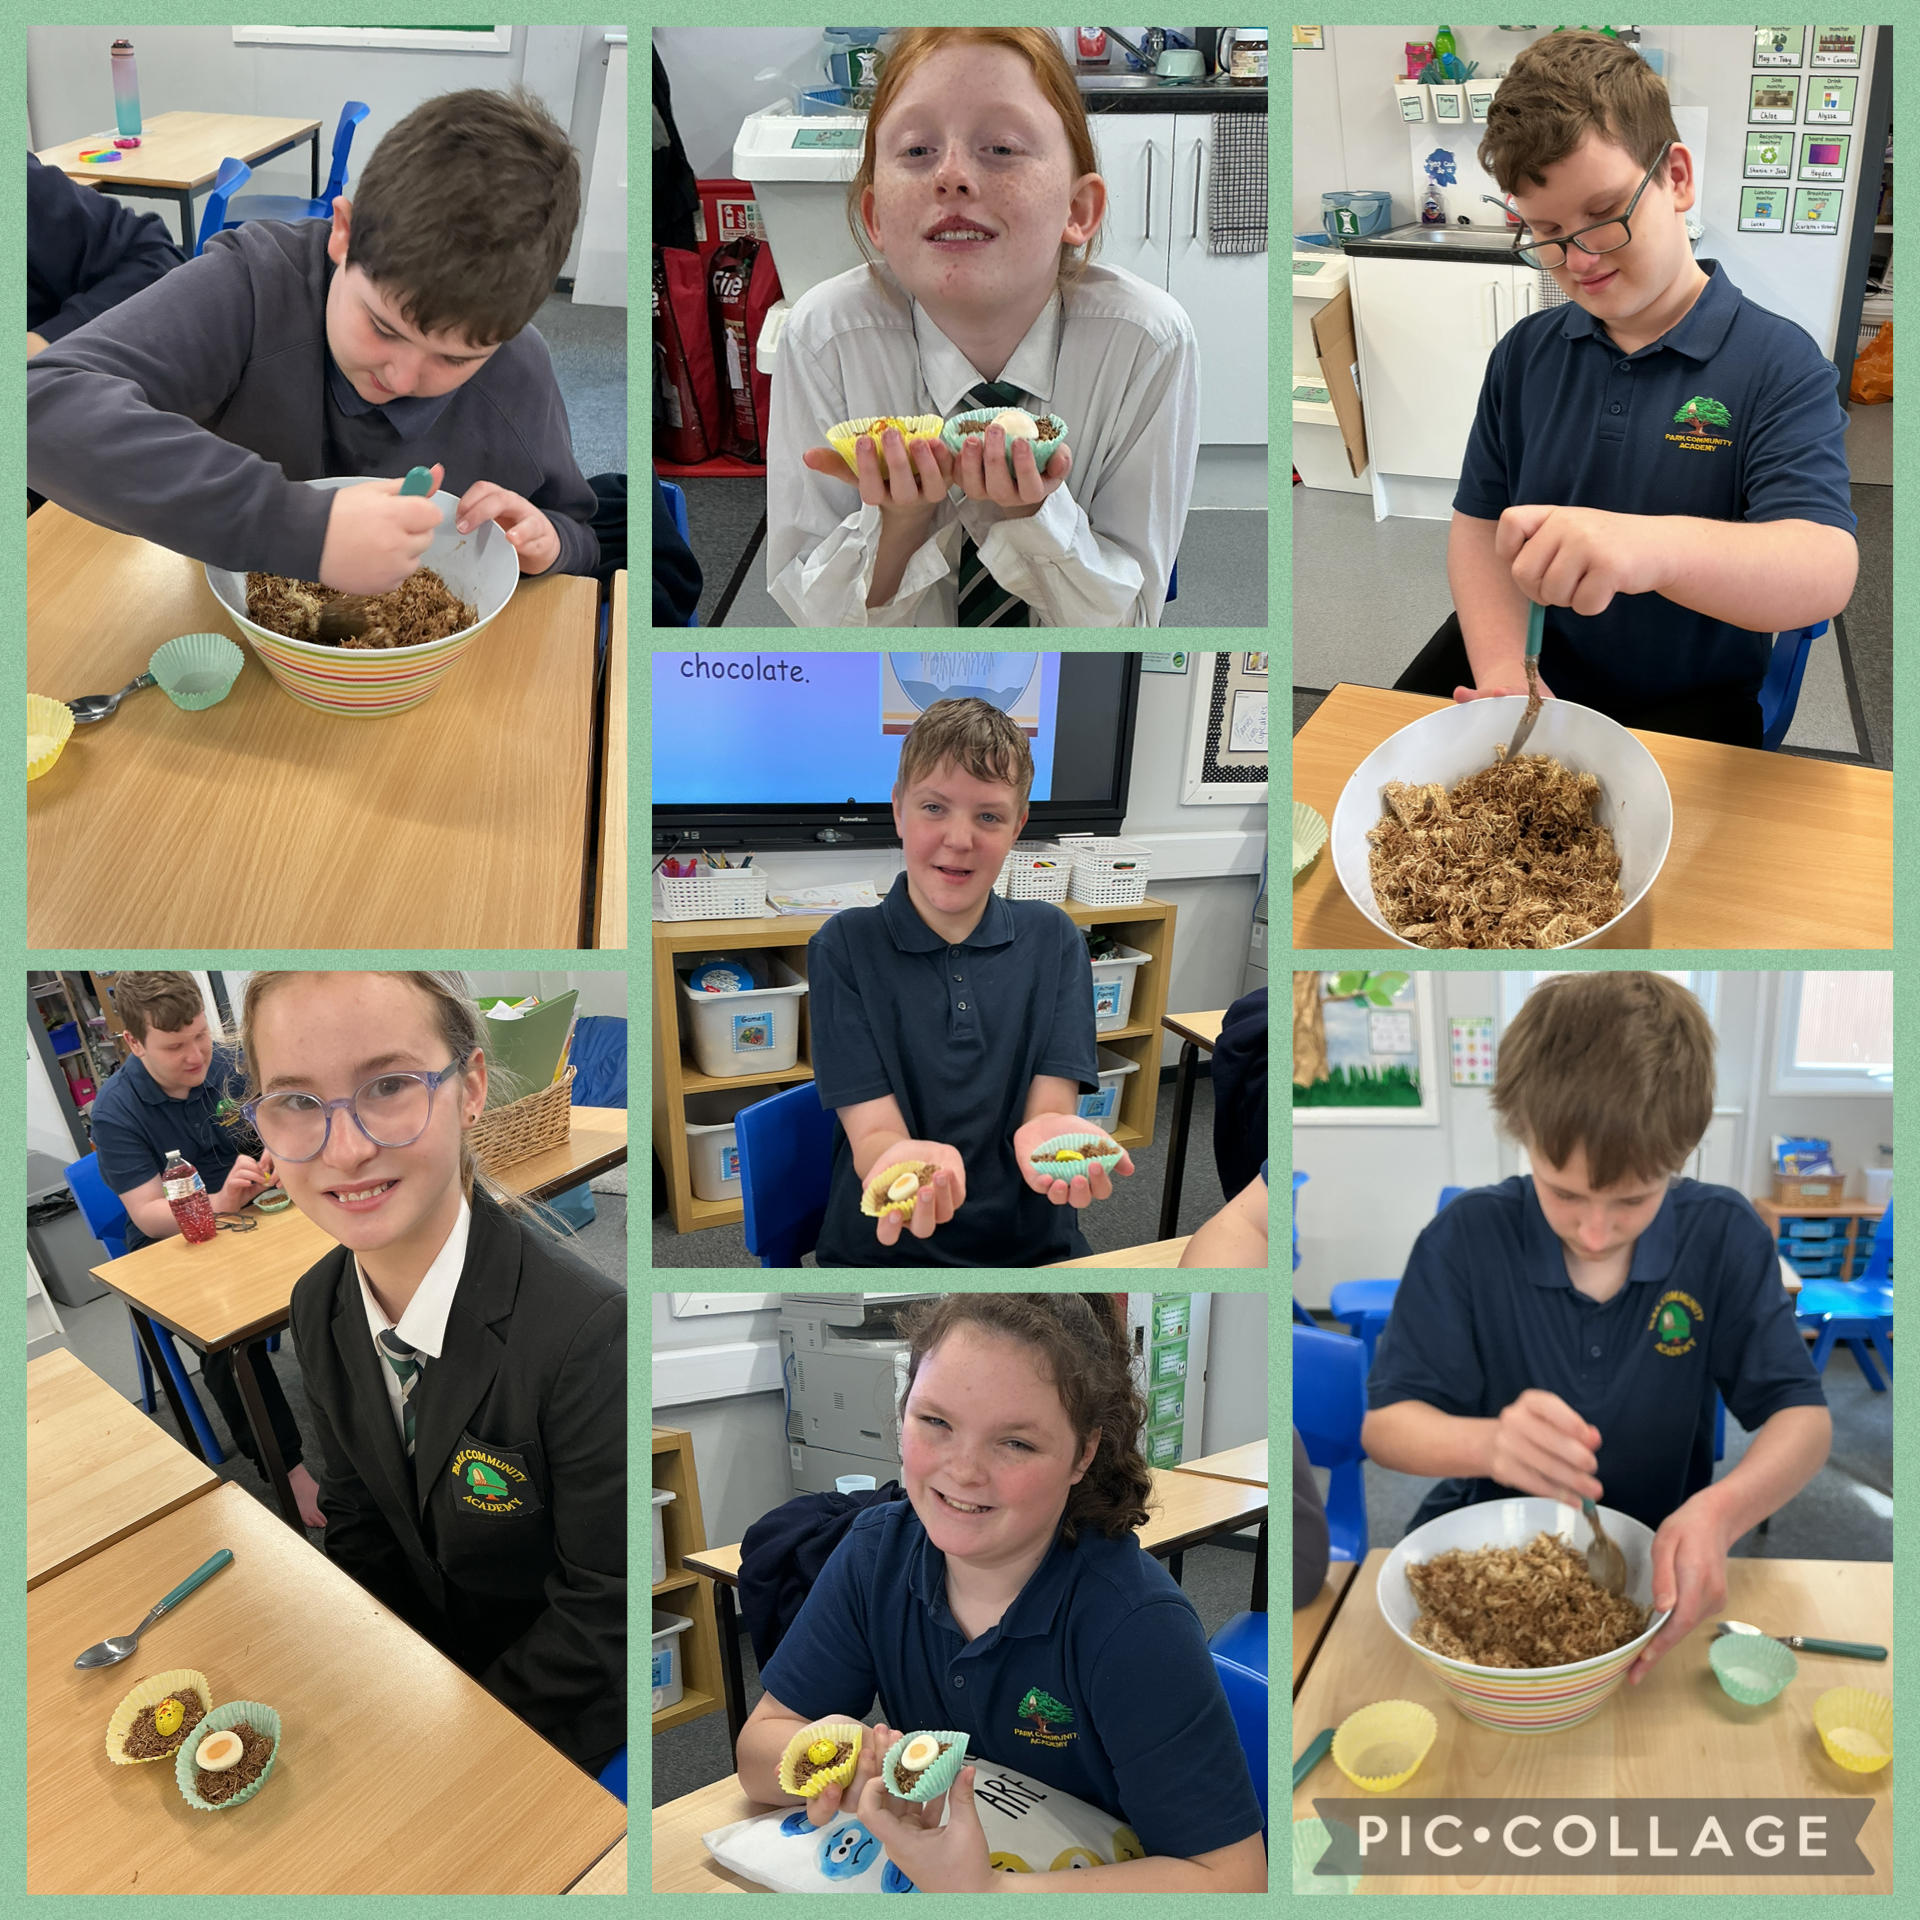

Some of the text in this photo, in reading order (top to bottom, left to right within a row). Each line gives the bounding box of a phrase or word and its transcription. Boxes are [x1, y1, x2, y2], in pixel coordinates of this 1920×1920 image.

[1810, 169, 1833, 178] Hayden
[1665, 433, 1733, 447] PARK COMMUNITY
[1679, 442, 1717, 452] ACADEMY
[680, 652, 810, 683] chocolate.
[741, 1015, 766, 1023] Games
[452, 1449, 528, 1483] PARK COMMUNITY
[462, 1495, 523, 1513] ACADEMY
[974, 1774, 1047, 1819] ARE
